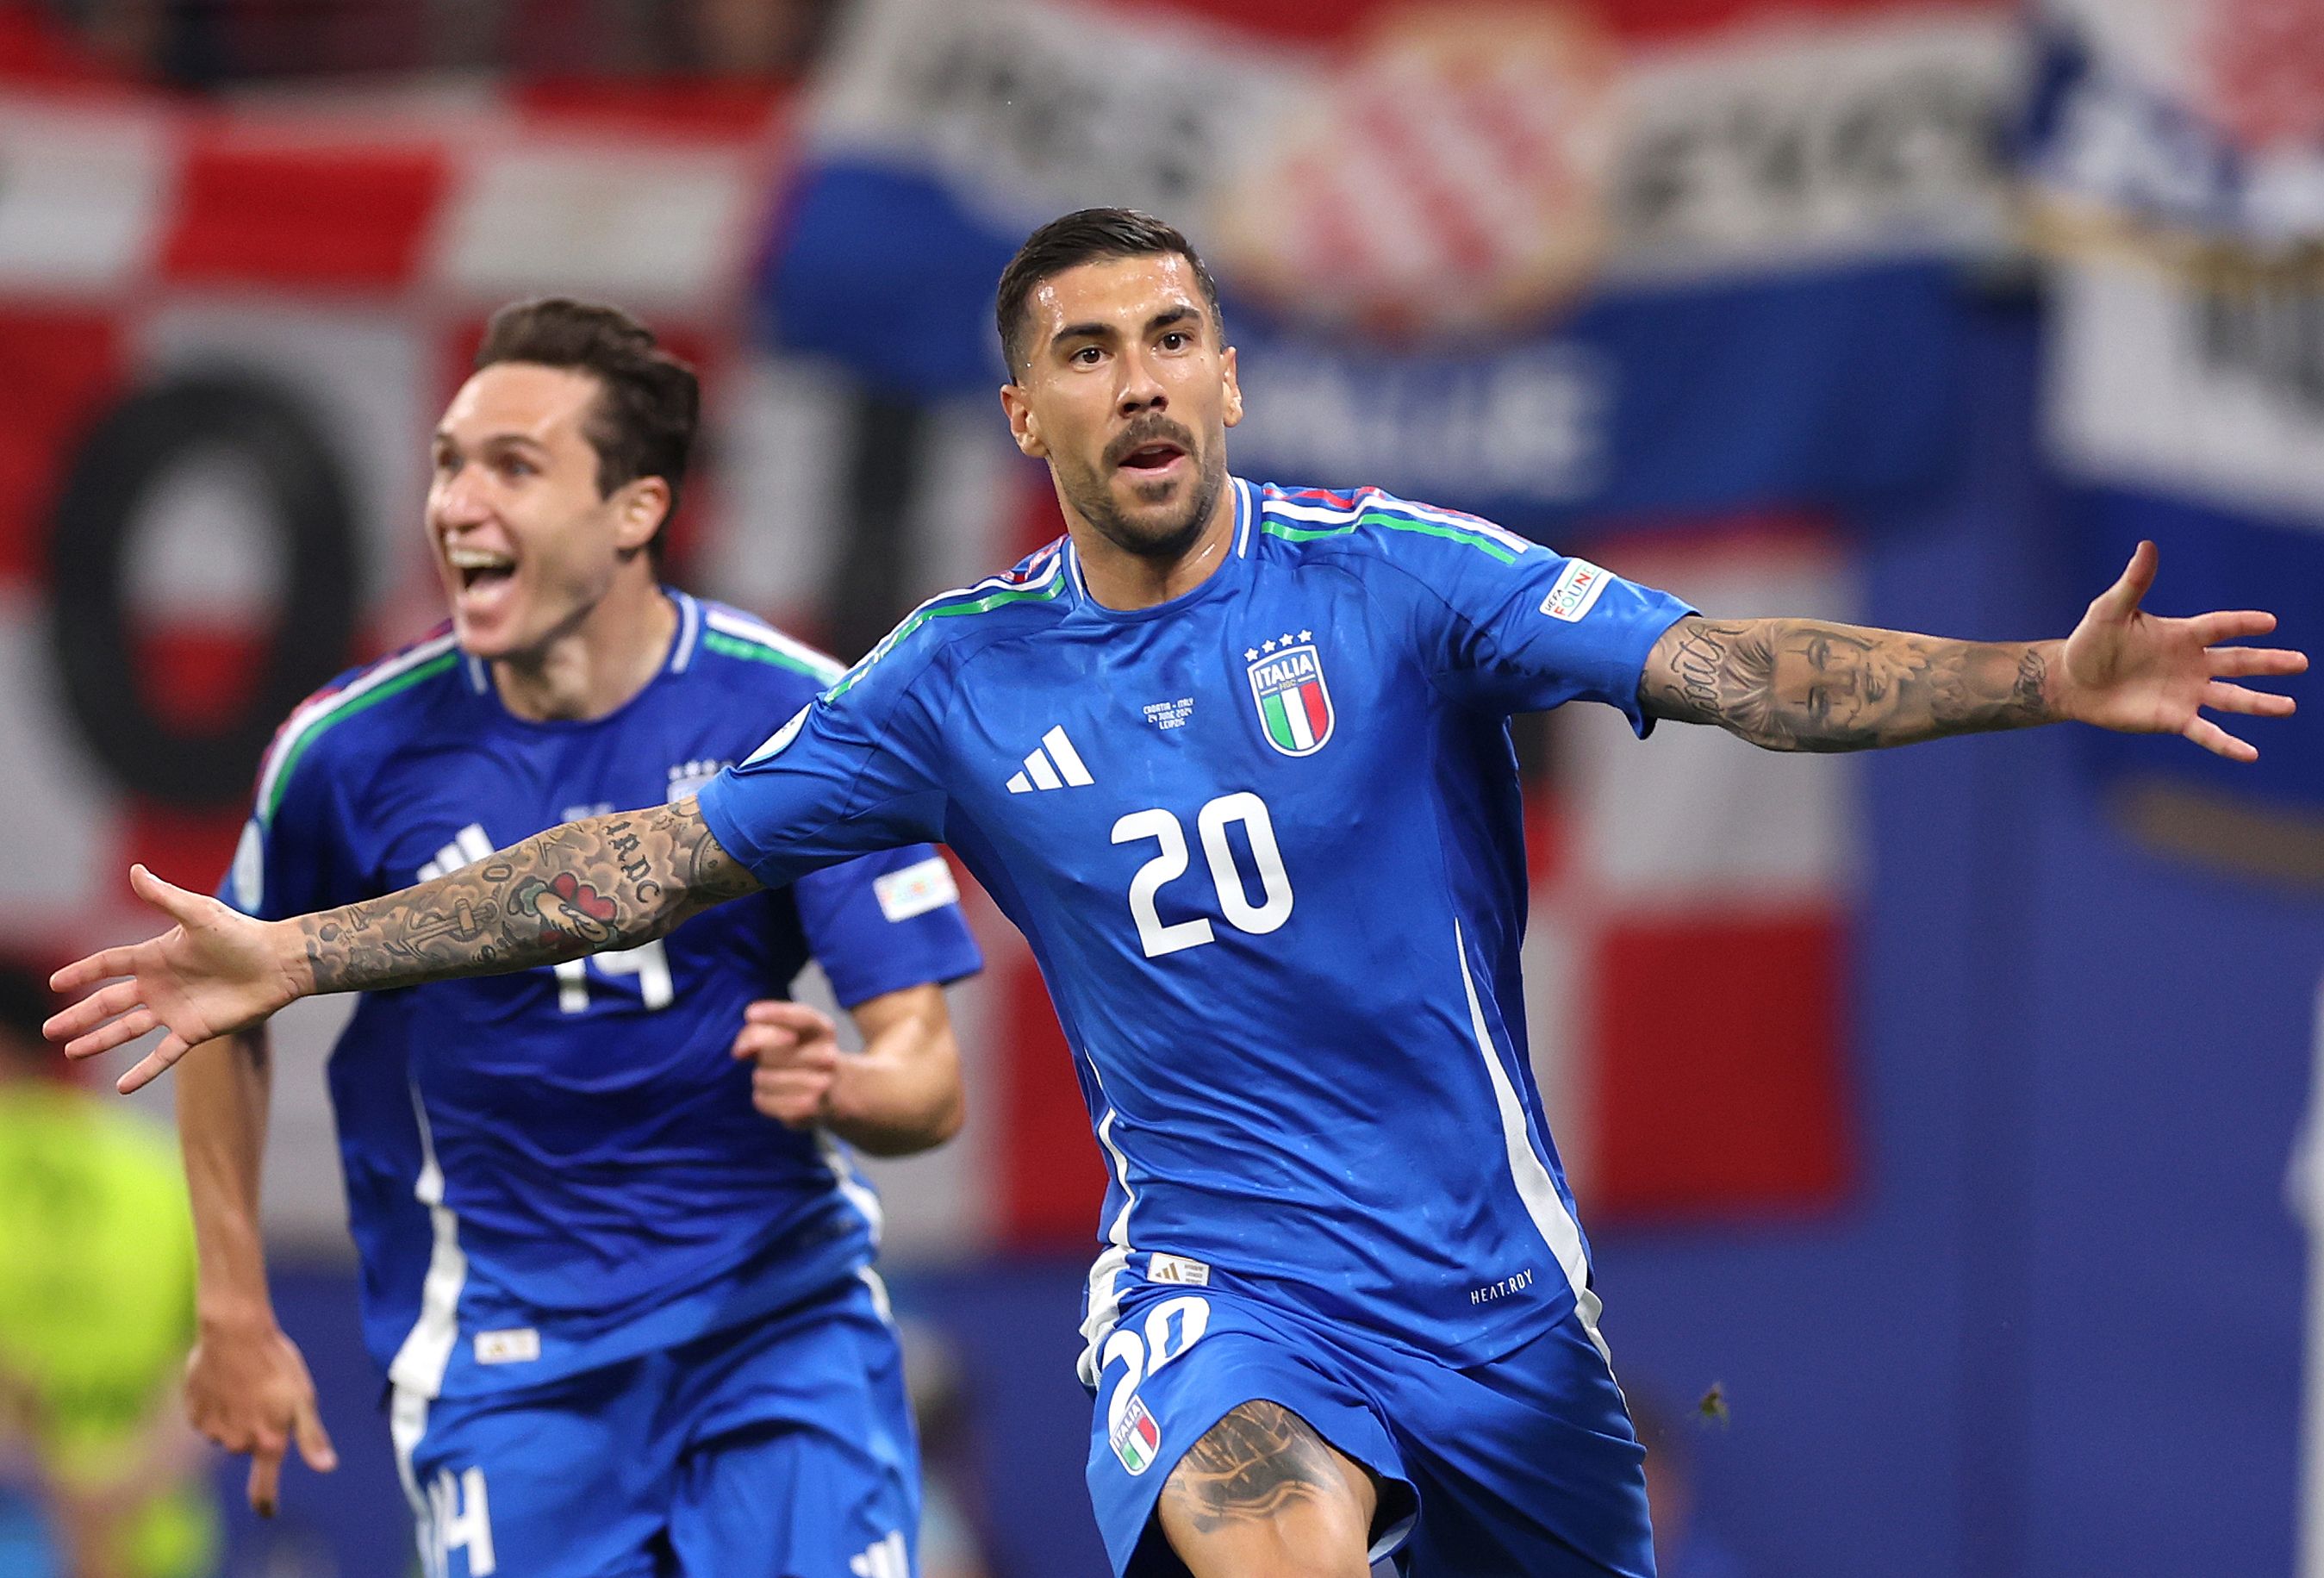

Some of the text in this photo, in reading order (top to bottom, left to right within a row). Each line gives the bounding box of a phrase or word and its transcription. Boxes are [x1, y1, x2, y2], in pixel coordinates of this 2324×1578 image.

[1545, 589, 1563, 611] UEFA
[1254, 653, 1314, 690] ITALIA
[1143, 702, 1171, 714] CROATIA
[1177, 697, 1193, 708] ITALY
[1148, 708, 1193, 723] 24 JUNE 2024
[1159, 718, 1186, 730] LEIPZIG
[1111, 790, 1295, 958] 20
[1470, 1268, 1533, 1306] HEAT.RDY
[1101, 1295, 1211, 1441] 20
[1112, 1402, 1143, 1449] ITALIA
